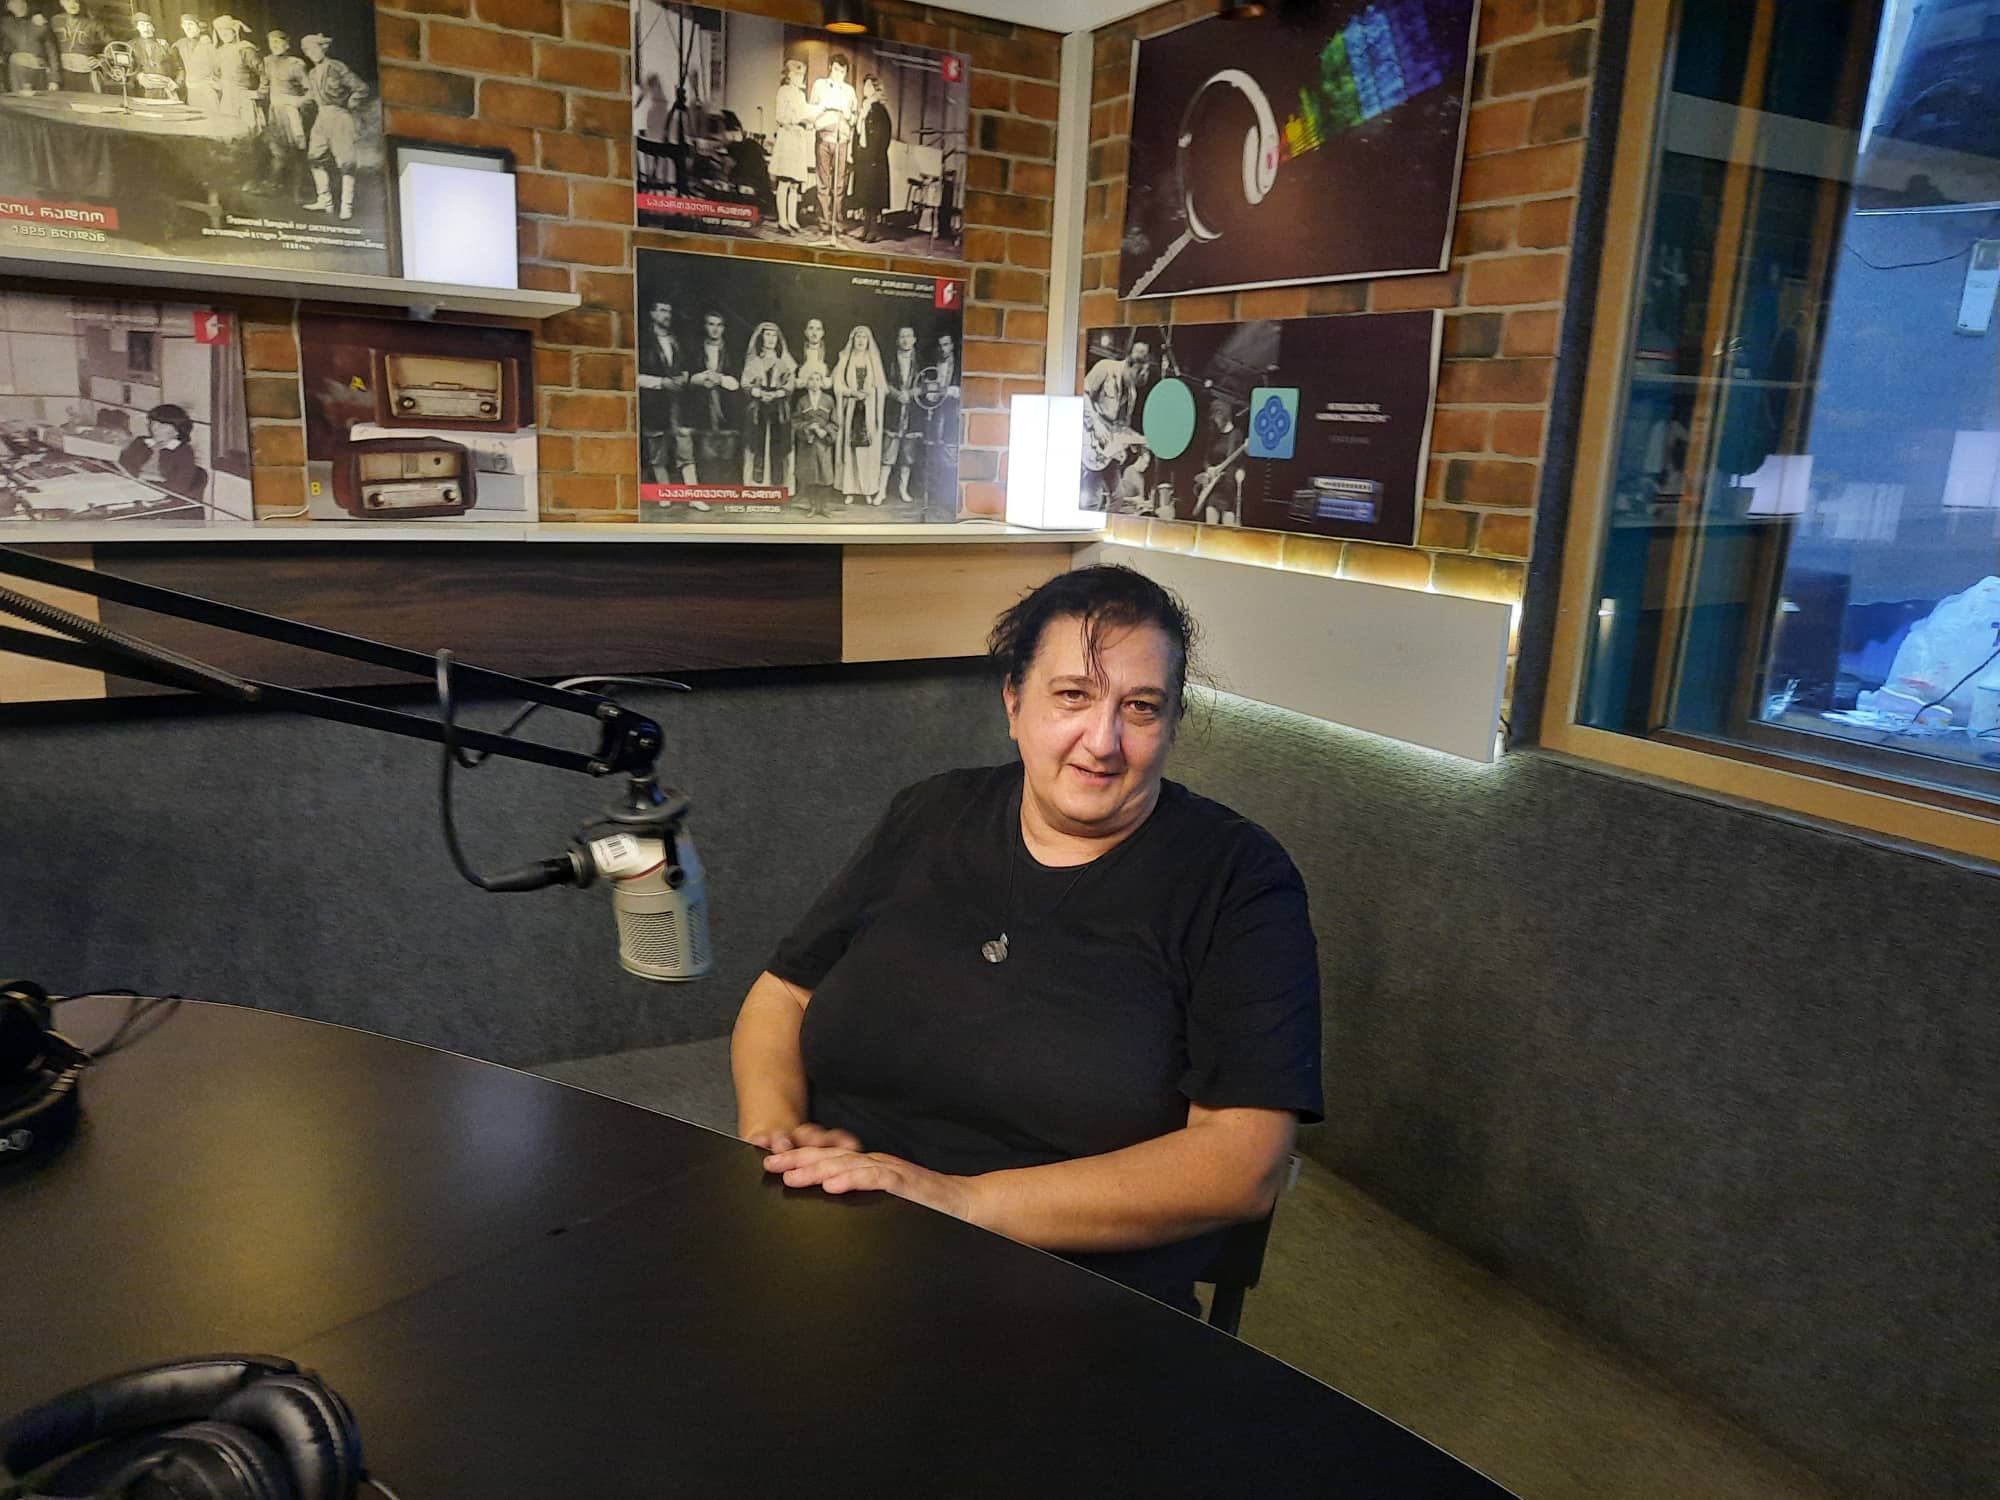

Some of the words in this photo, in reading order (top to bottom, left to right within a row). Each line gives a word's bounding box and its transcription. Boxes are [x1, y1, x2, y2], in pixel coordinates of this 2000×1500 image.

[40, 207, 105, 223] რადიო
[11, 225, 46, 237] 1925
[658, 488, 739, 498] საქართველოს
